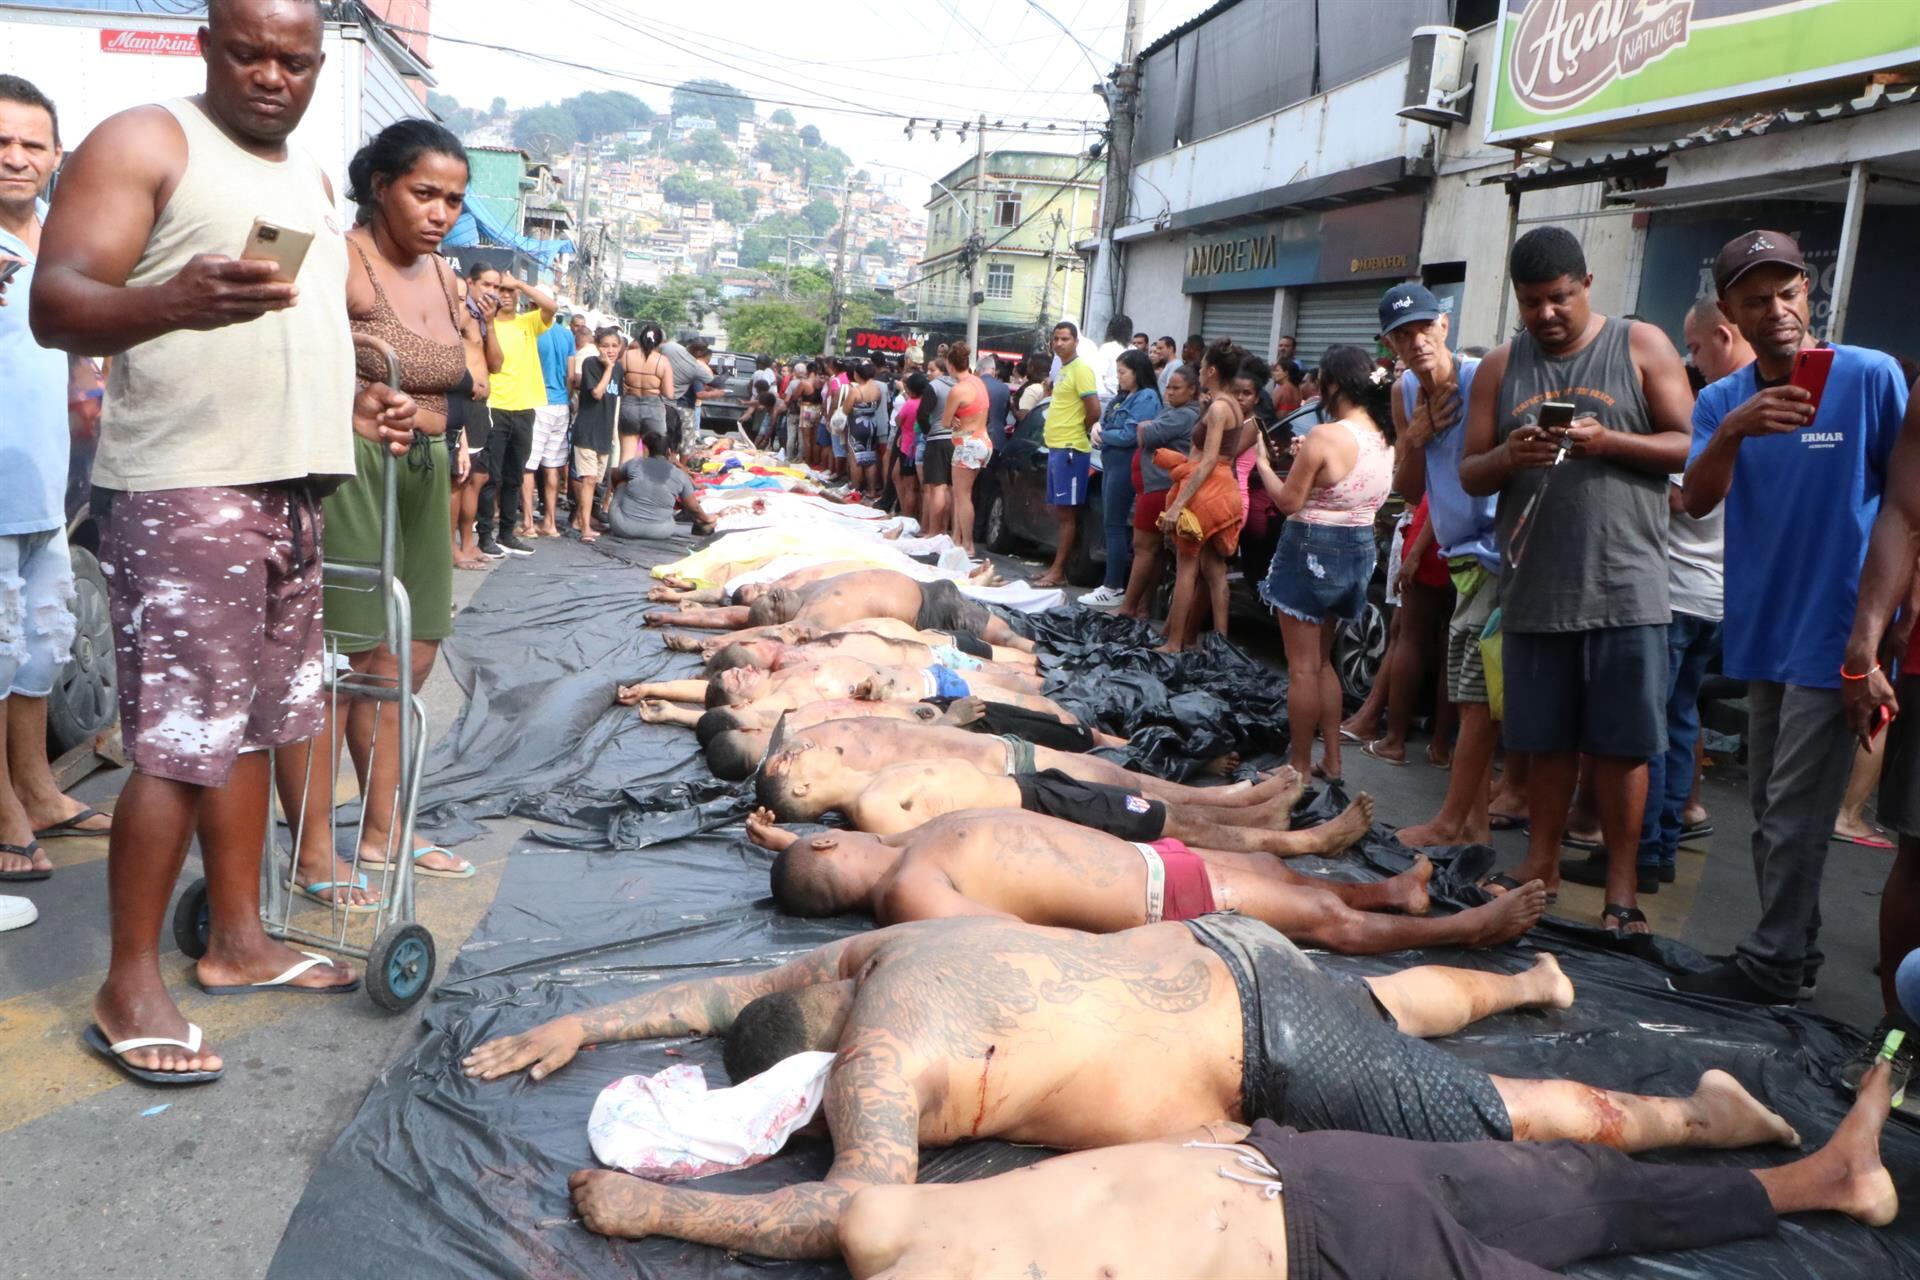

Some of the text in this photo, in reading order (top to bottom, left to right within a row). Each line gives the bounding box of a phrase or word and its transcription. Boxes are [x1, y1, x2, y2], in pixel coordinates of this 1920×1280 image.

[1624, 10, 1682, 65] NATUICE
[1187, 234, 1276, 277] MORENA
[1801, 432, 1844, 442] ERMAR
